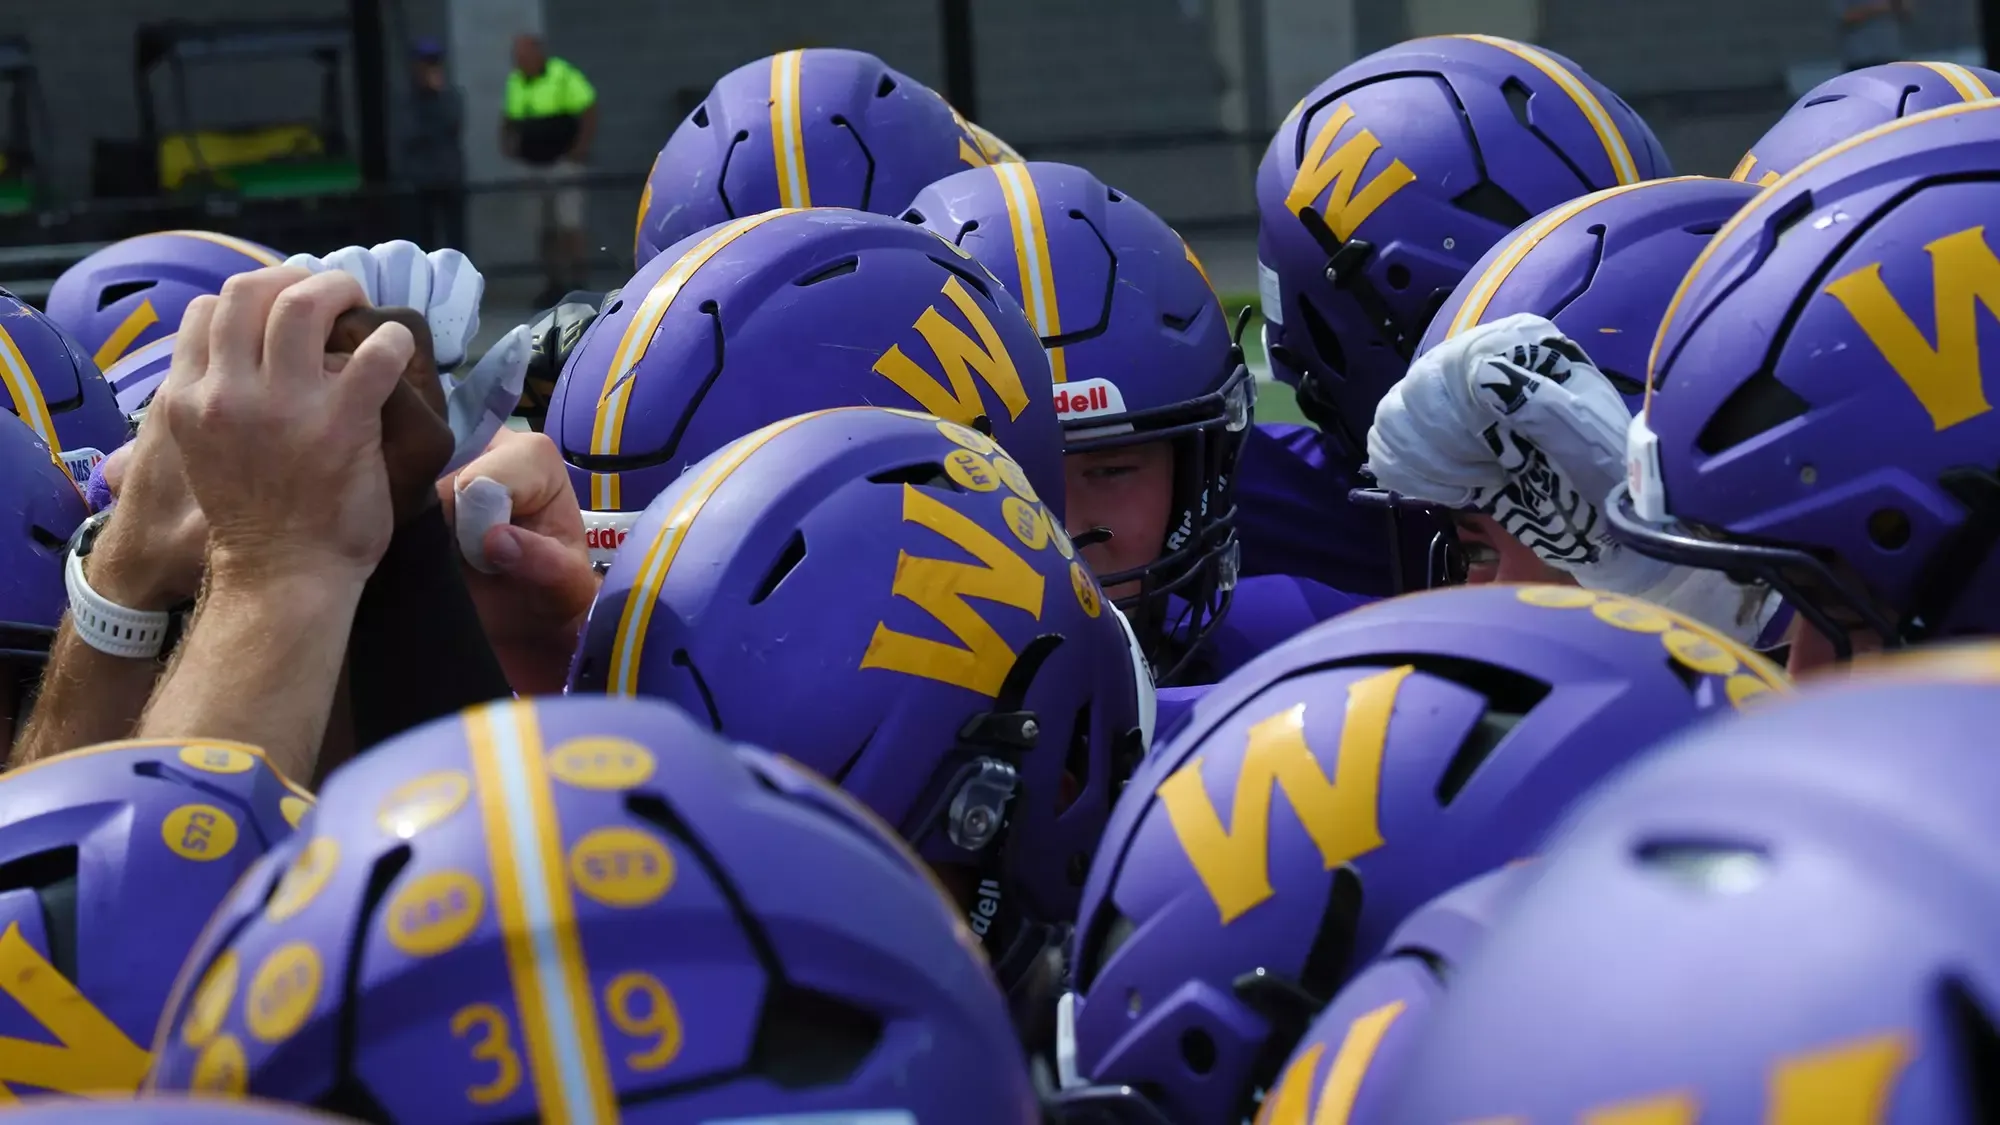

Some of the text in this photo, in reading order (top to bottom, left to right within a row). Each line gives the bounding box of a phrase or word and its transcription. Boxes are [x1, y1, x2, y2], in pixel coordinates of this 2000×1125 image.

[1284, 101, 1416, 243] W
[872, 274, 1030, 437] W
[954, 454, 991, 486] RTC
[859, 482, 1045, 698] W
[1156, 674, 1416, 927] W
